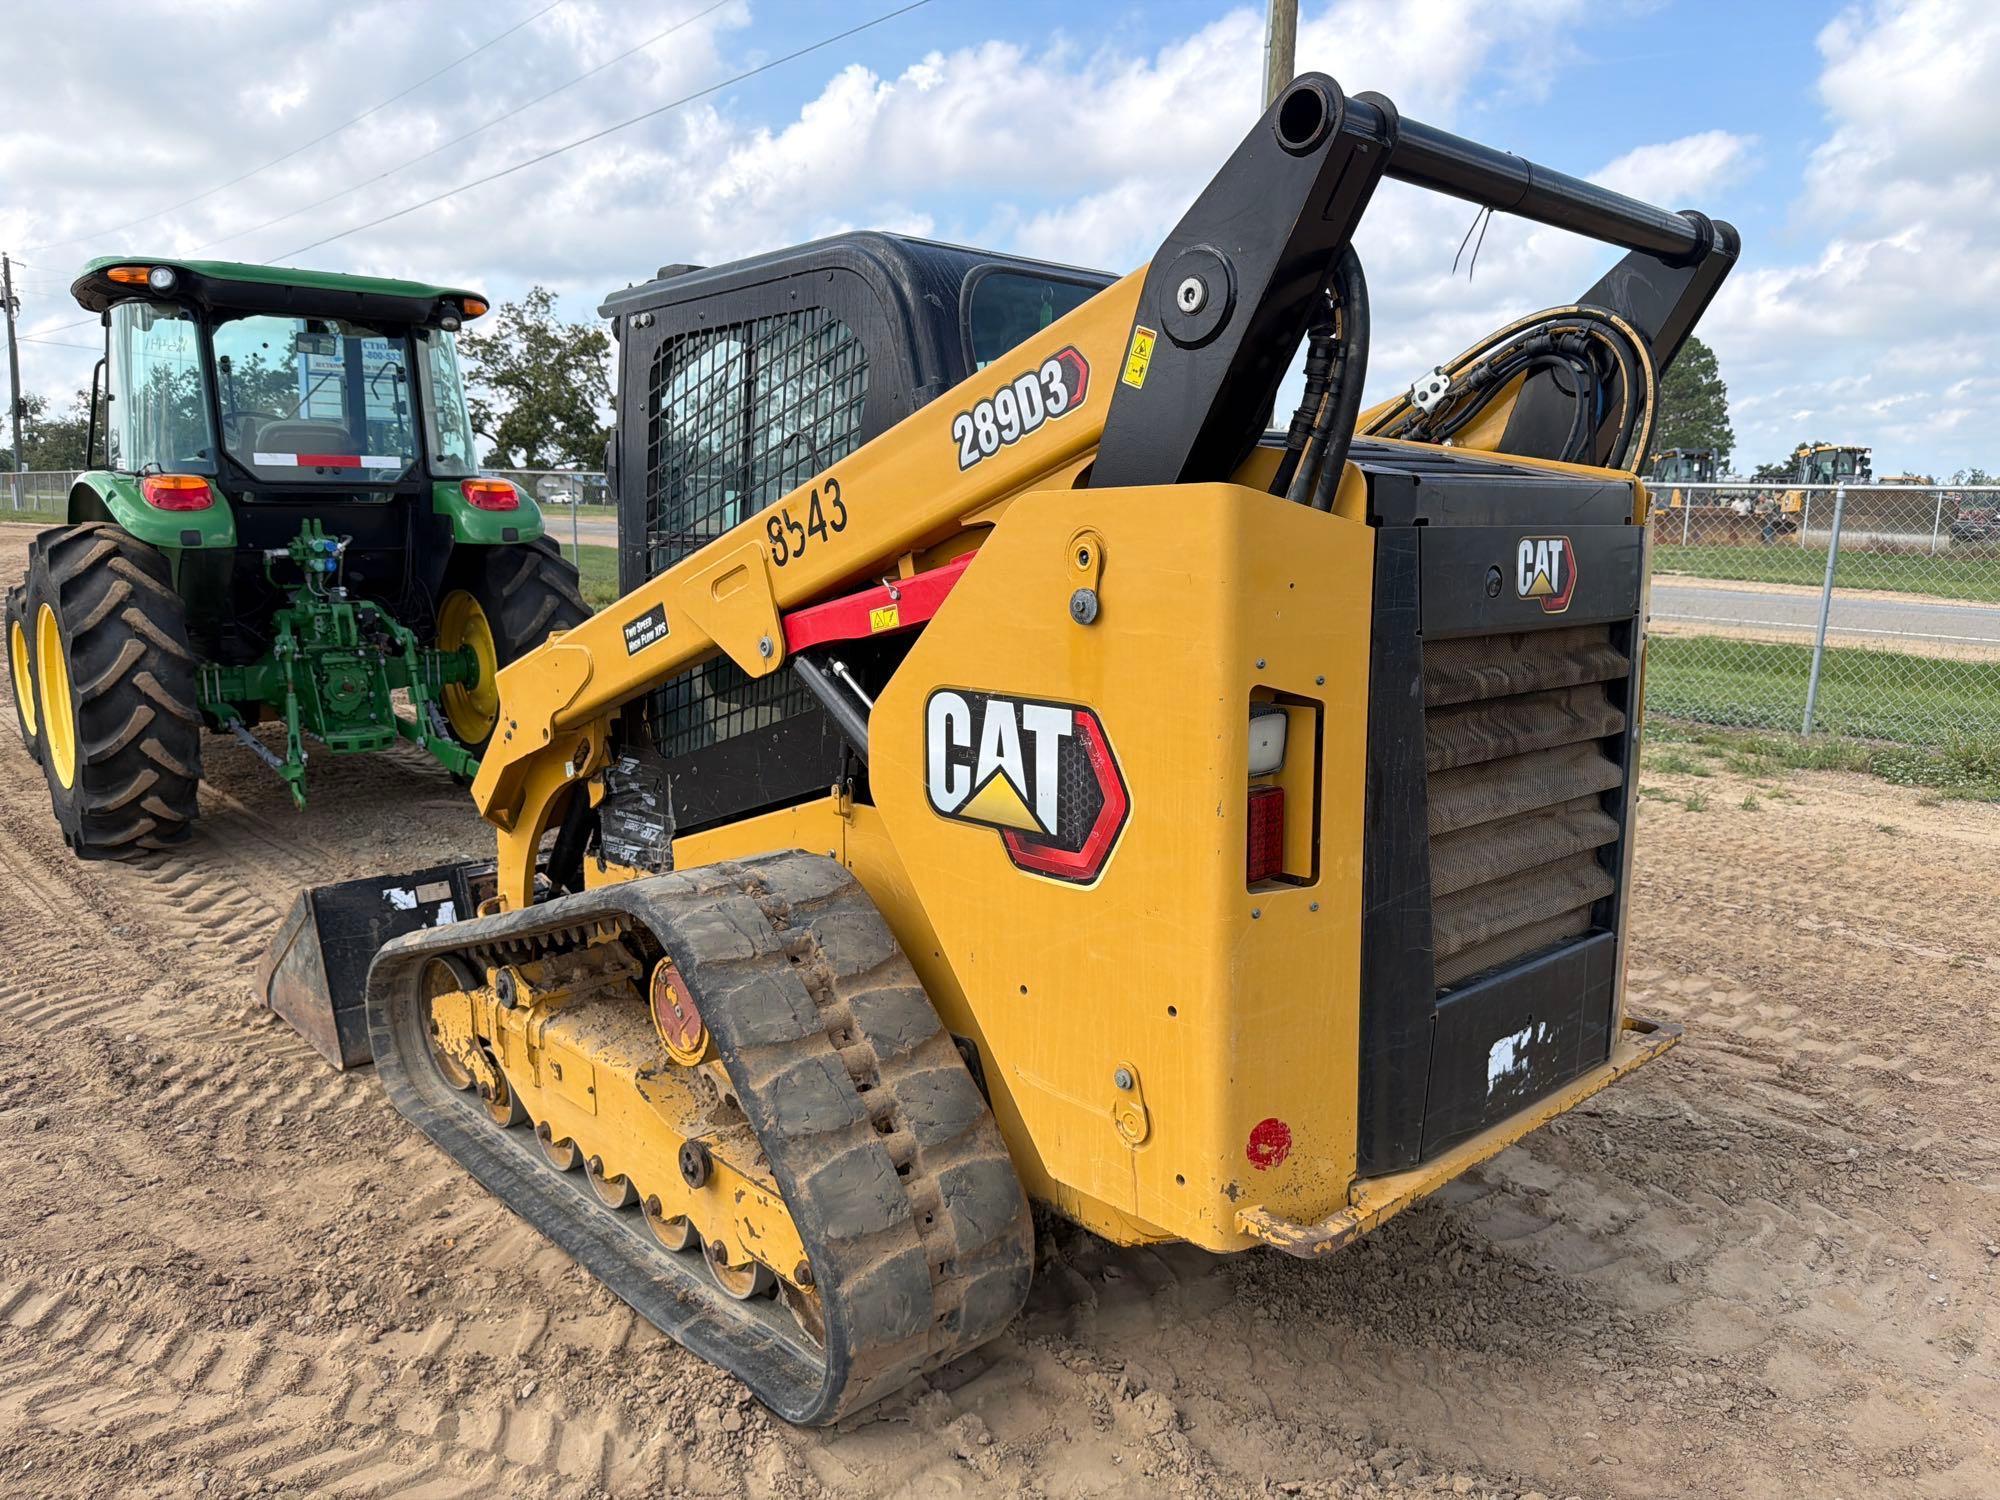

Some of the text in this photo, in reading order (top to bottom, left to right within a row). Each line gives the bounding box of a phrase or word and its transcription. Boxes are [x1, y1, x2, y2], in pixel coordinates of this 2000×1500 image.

[954, 360, 1068, 468] 289D3
[767, 478, 847, 567] 8543
[1518, 540, 1563, 596] CAT
[928, 692, 1073, 836] CAT
